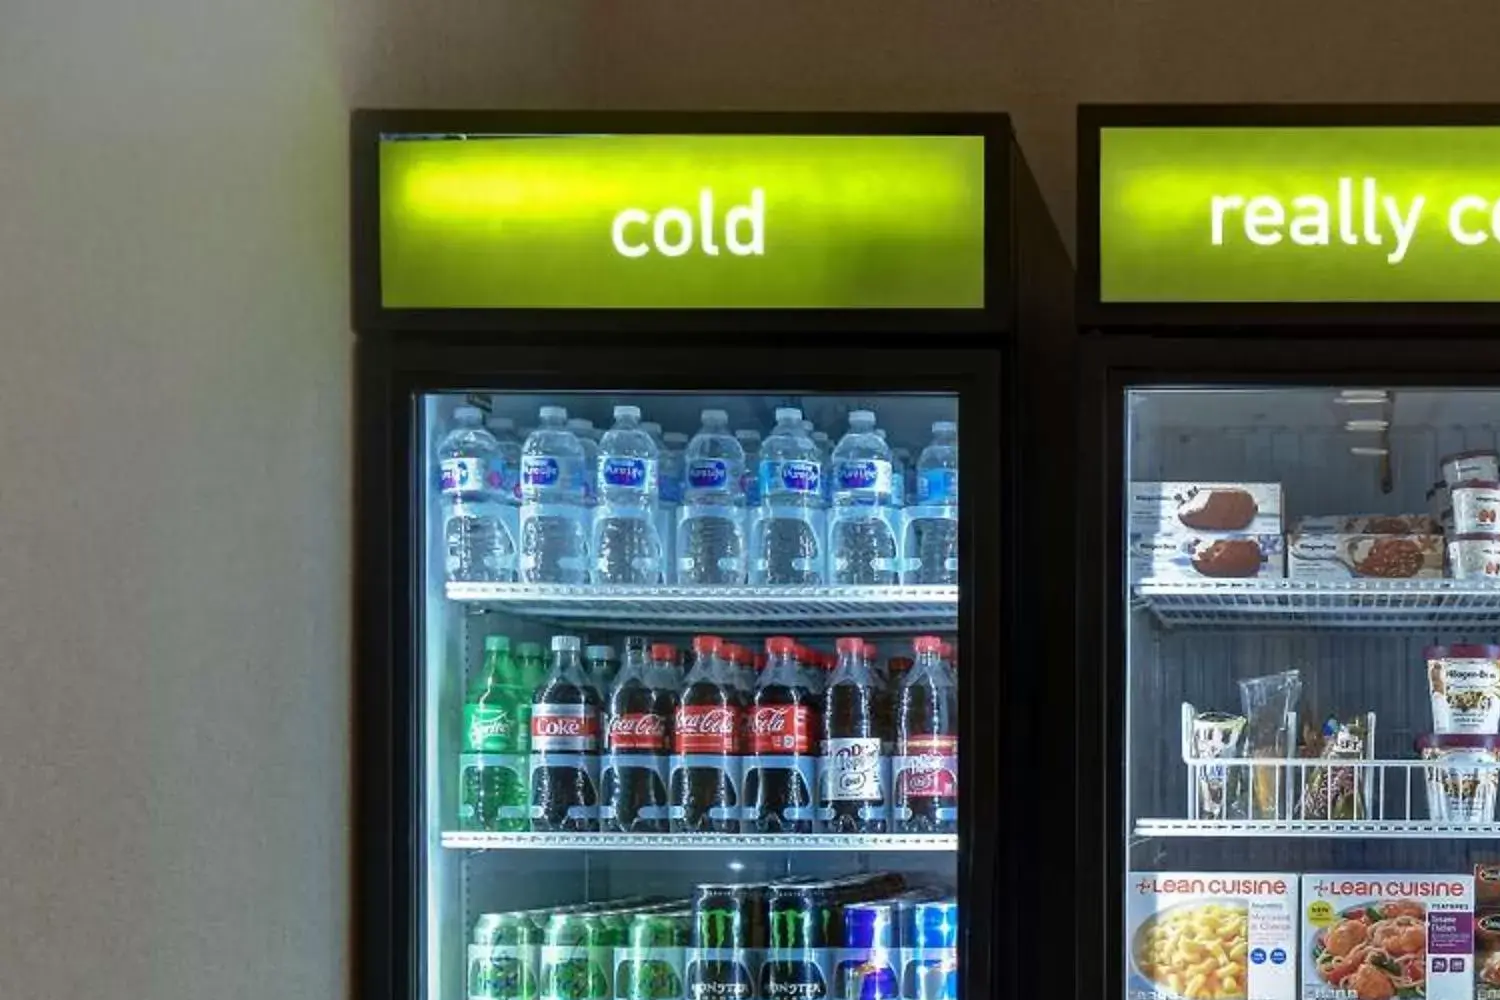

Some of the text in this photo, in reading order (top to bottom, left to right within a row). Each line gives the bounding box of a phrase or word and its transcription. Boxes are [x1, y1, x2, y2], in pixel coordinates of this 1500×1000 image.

[611, 187, 765, 257] cold
[1210, 176, 1426, 263] really
[536, 718, 580, 735] Coke
[1153, 877, 1286, 895] Lean cuisine
[1330, 879, 1464, 896] Lean cuisine
